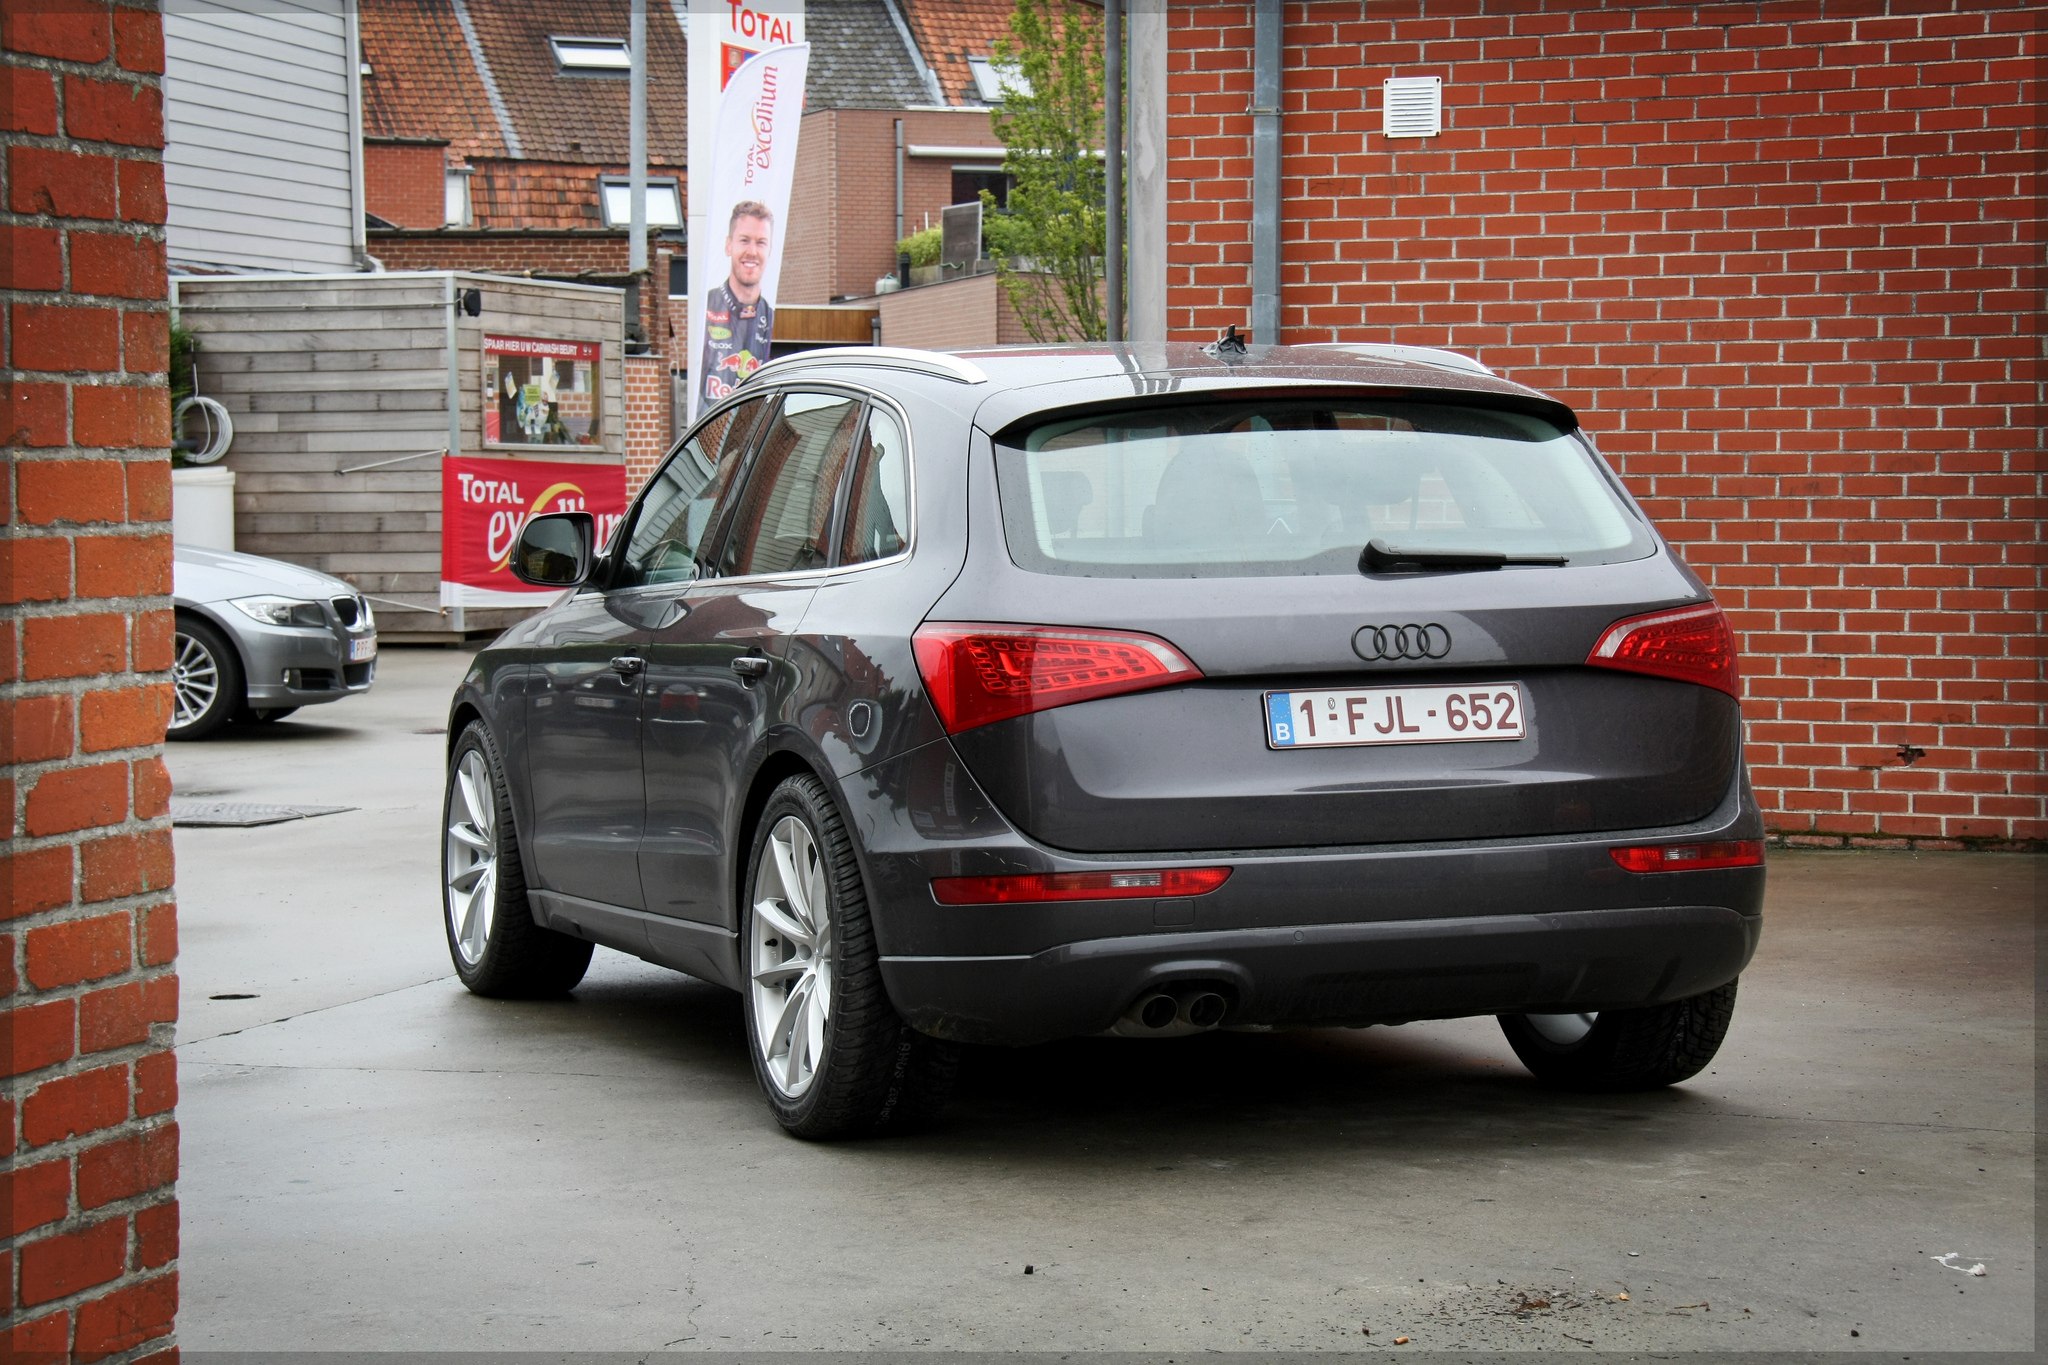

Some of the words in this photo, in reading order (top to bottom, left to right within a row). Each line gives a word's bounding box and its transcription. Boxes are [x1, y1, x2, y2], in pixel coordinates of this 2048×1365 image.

[726, 0, 797, 44] TOTAL
[756, 65, 778, 169] excellium
[744, 144, 755, 187] TOTAL
[484, 338, 504, 350] SPAAR
[505, 340, 520, 351] HIER
[532, 342, 559, 354] CARWASH
[560, 344, 577, 356] BEURT
[457, 473, 524, 504] TOTAL
[1275, 723, 1291, 741] B
